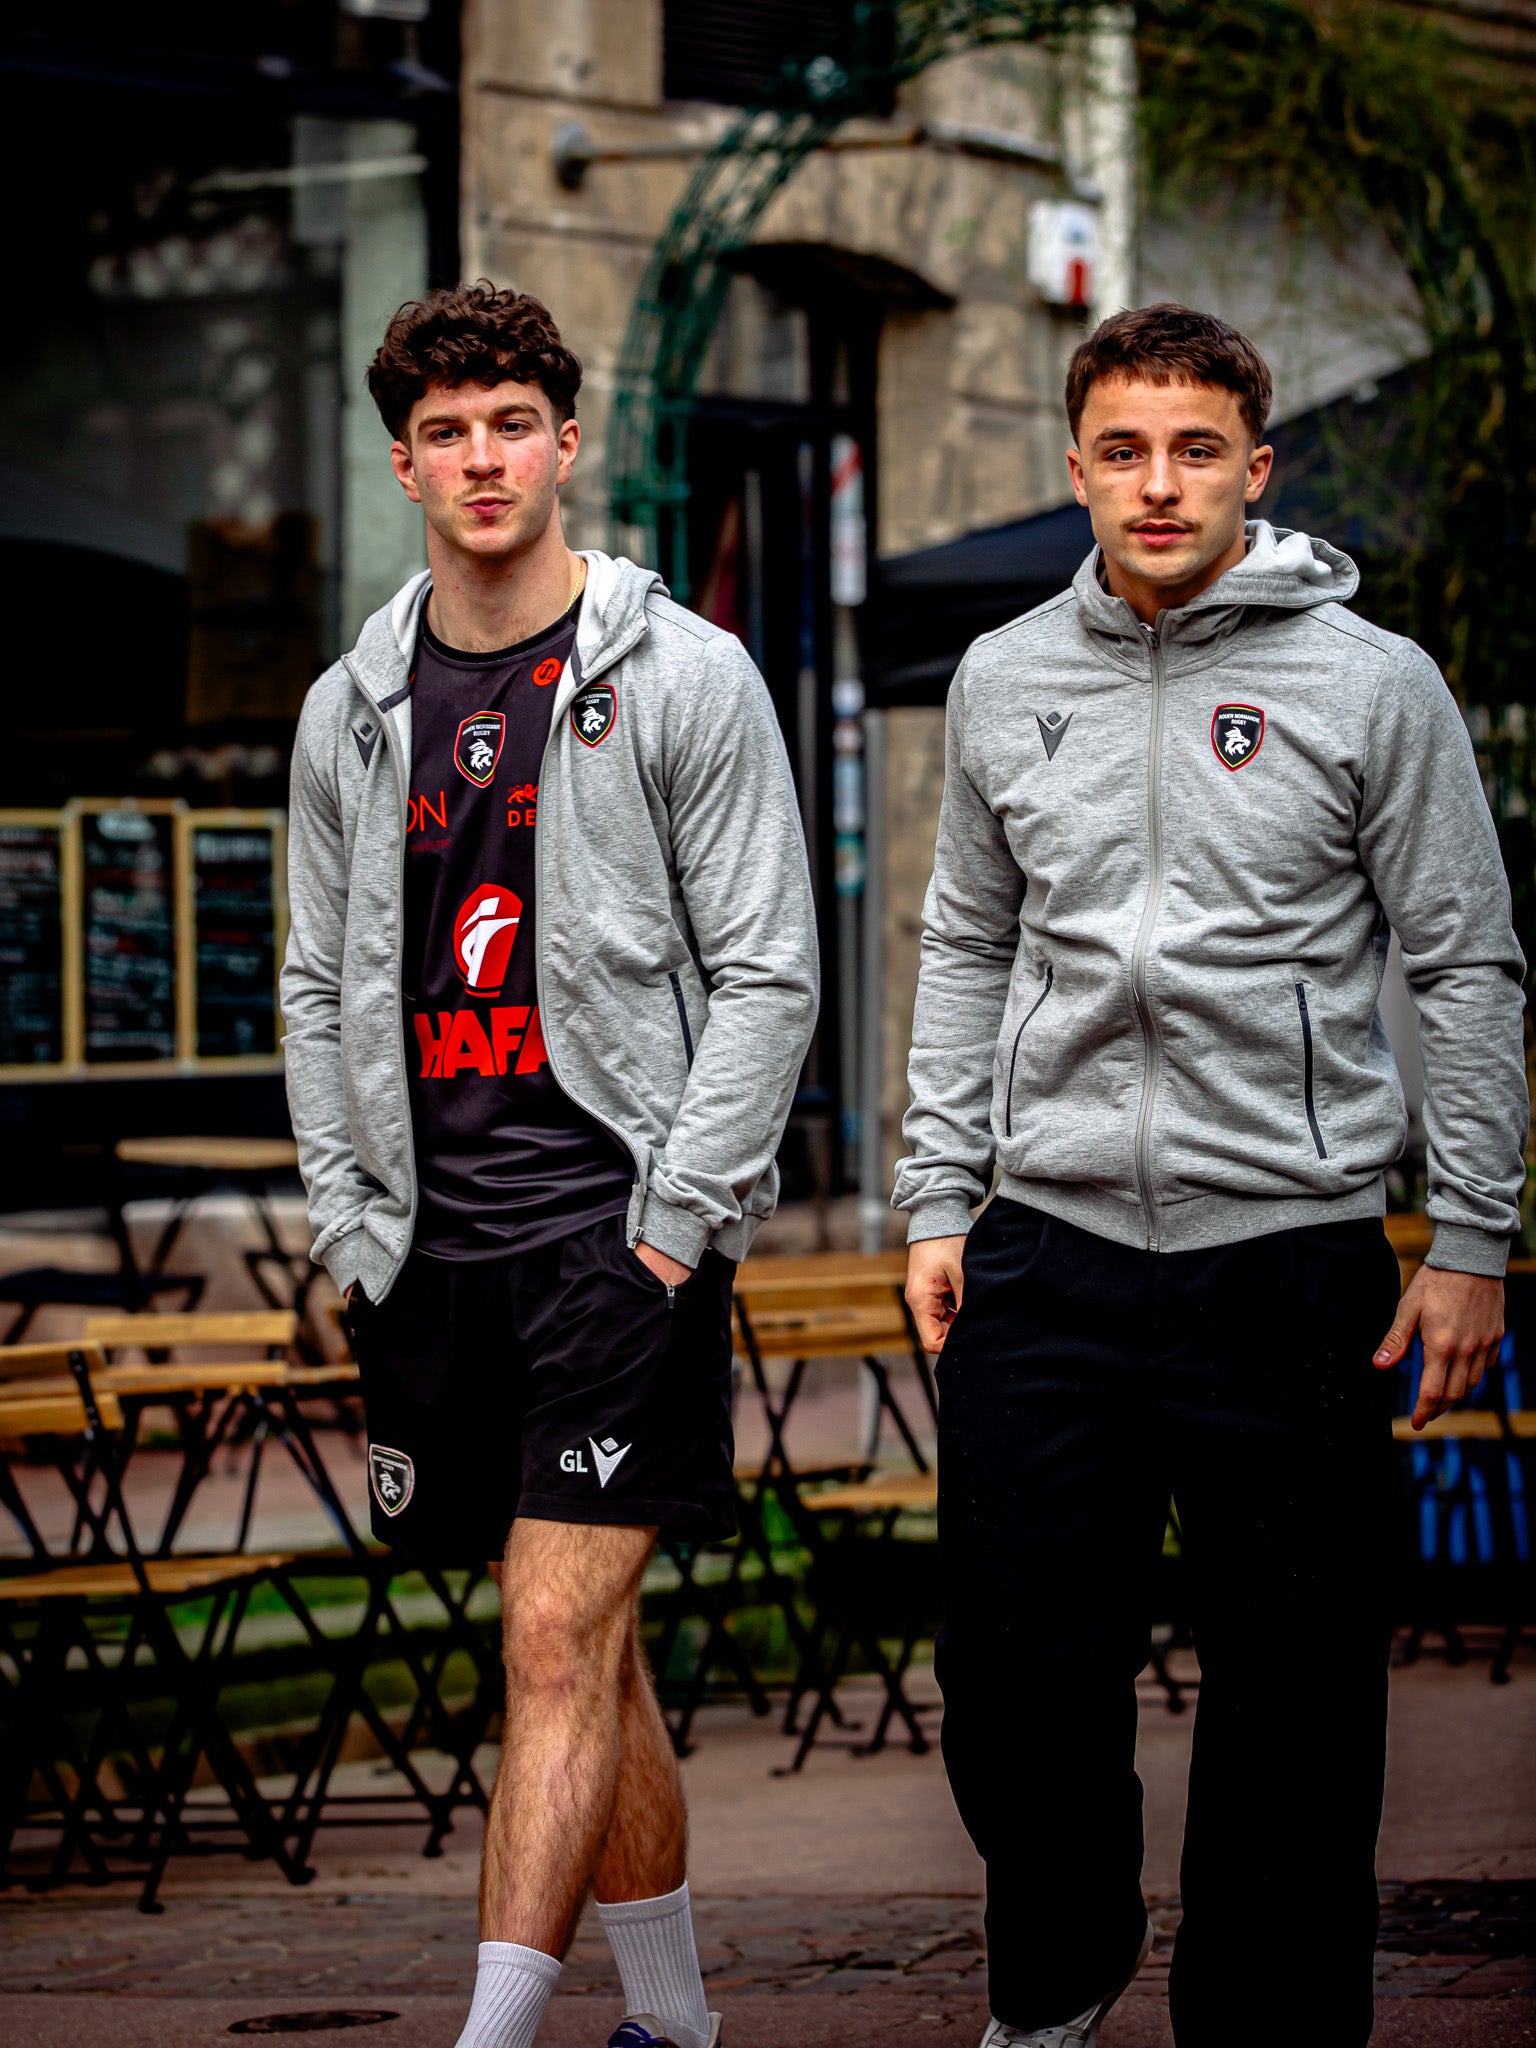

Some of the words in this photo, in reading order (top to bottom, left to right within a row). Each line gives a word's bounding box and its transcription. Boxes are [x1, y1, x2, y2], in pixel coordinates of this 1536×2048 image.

[1234, 713, 1260, 724] NORMANDIE
[507, 809, 537, 827] DE
[560, 1449, 588, 1473] GL
